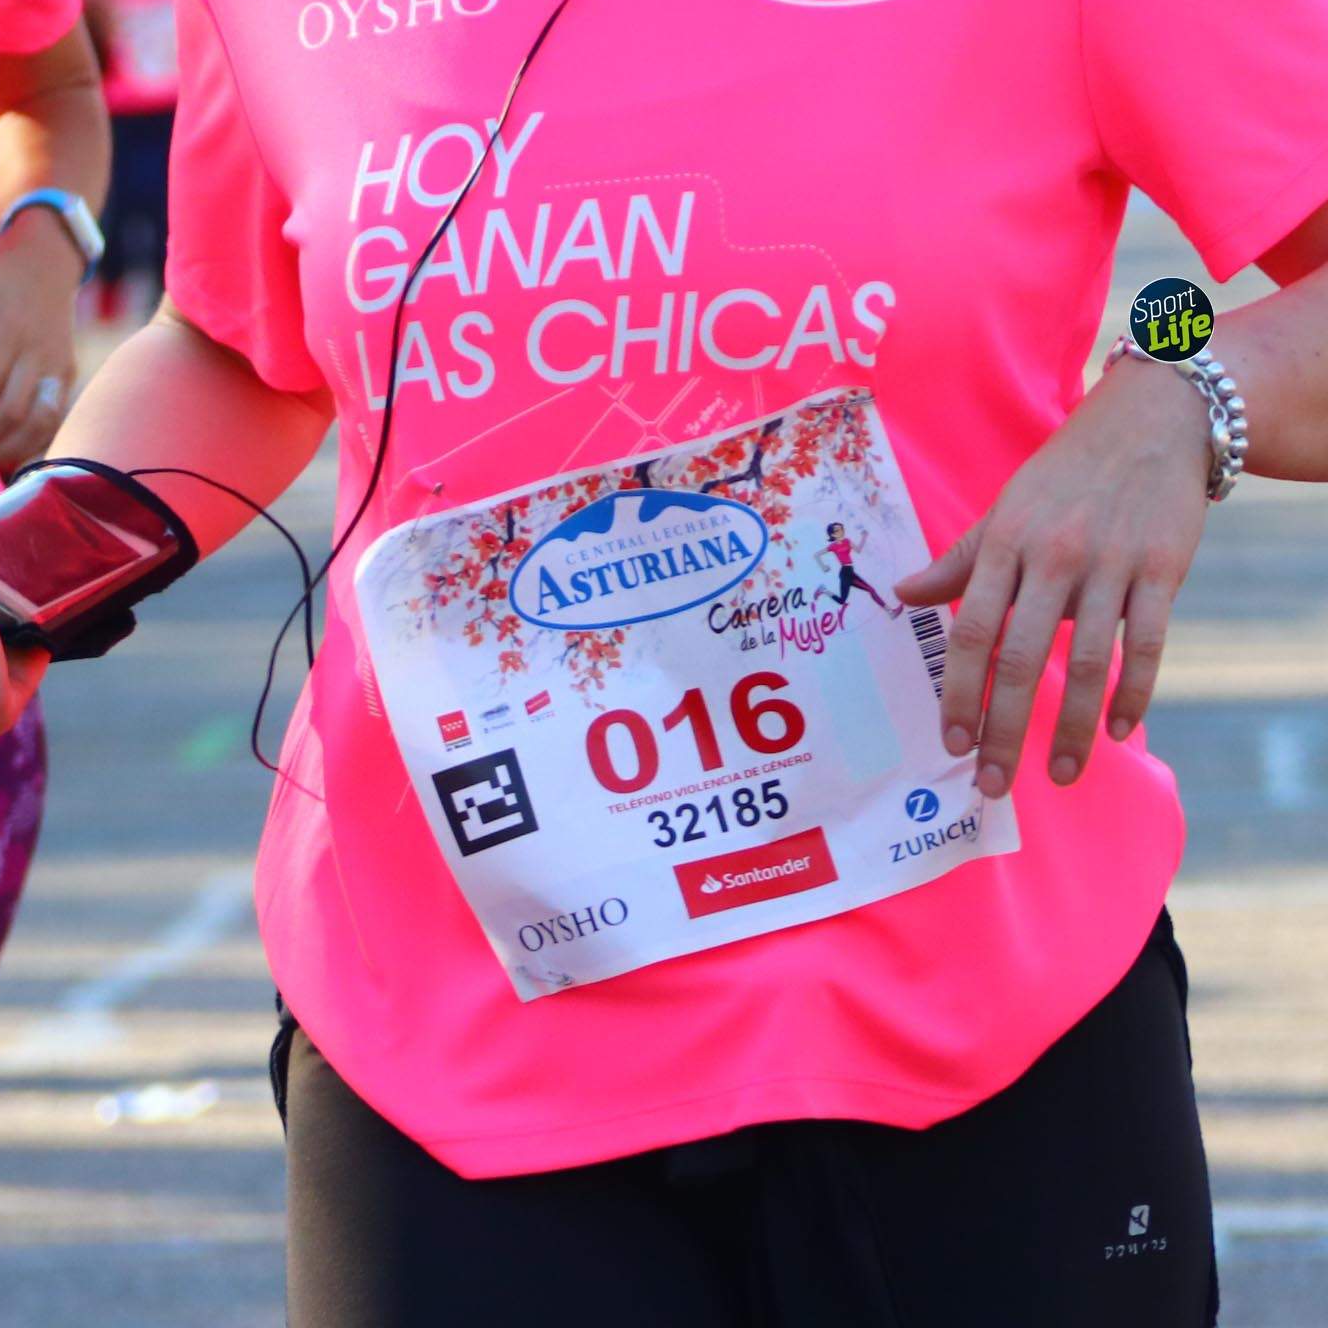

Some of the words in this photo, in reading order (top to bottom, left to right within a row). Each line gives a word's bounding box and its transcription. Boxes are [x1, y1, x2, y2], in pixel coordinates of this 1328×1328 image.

[348, 111, 545, 222] HOY
[344, 191, 695, 314] GANAN
[356, 310, 497, 411] LAS
[526, 280, 897, 384] CHICAS
[565, 534, 646, 565] CENTRAL
[652, 514, 732, 542] LECHERA
[533, 530, 754, 617] ASTURIANA
[708, 587, 807, 634] Carrera
[740, 630, 758, 651] de
[761, 625, 777, 646] la
[778, 602, 849, 661] Mujer
[583, 670, 808, 795] 016
[647, 778, 789, 848] 32185
[674, 773, 742, 797] VIOLENCIA
[744, 767, 760, 778] DE
[889, 815, 977, 863] ZURICH
[723, 856, 811, 889] Santander
[518, 897, 629, 953] OYSHO
